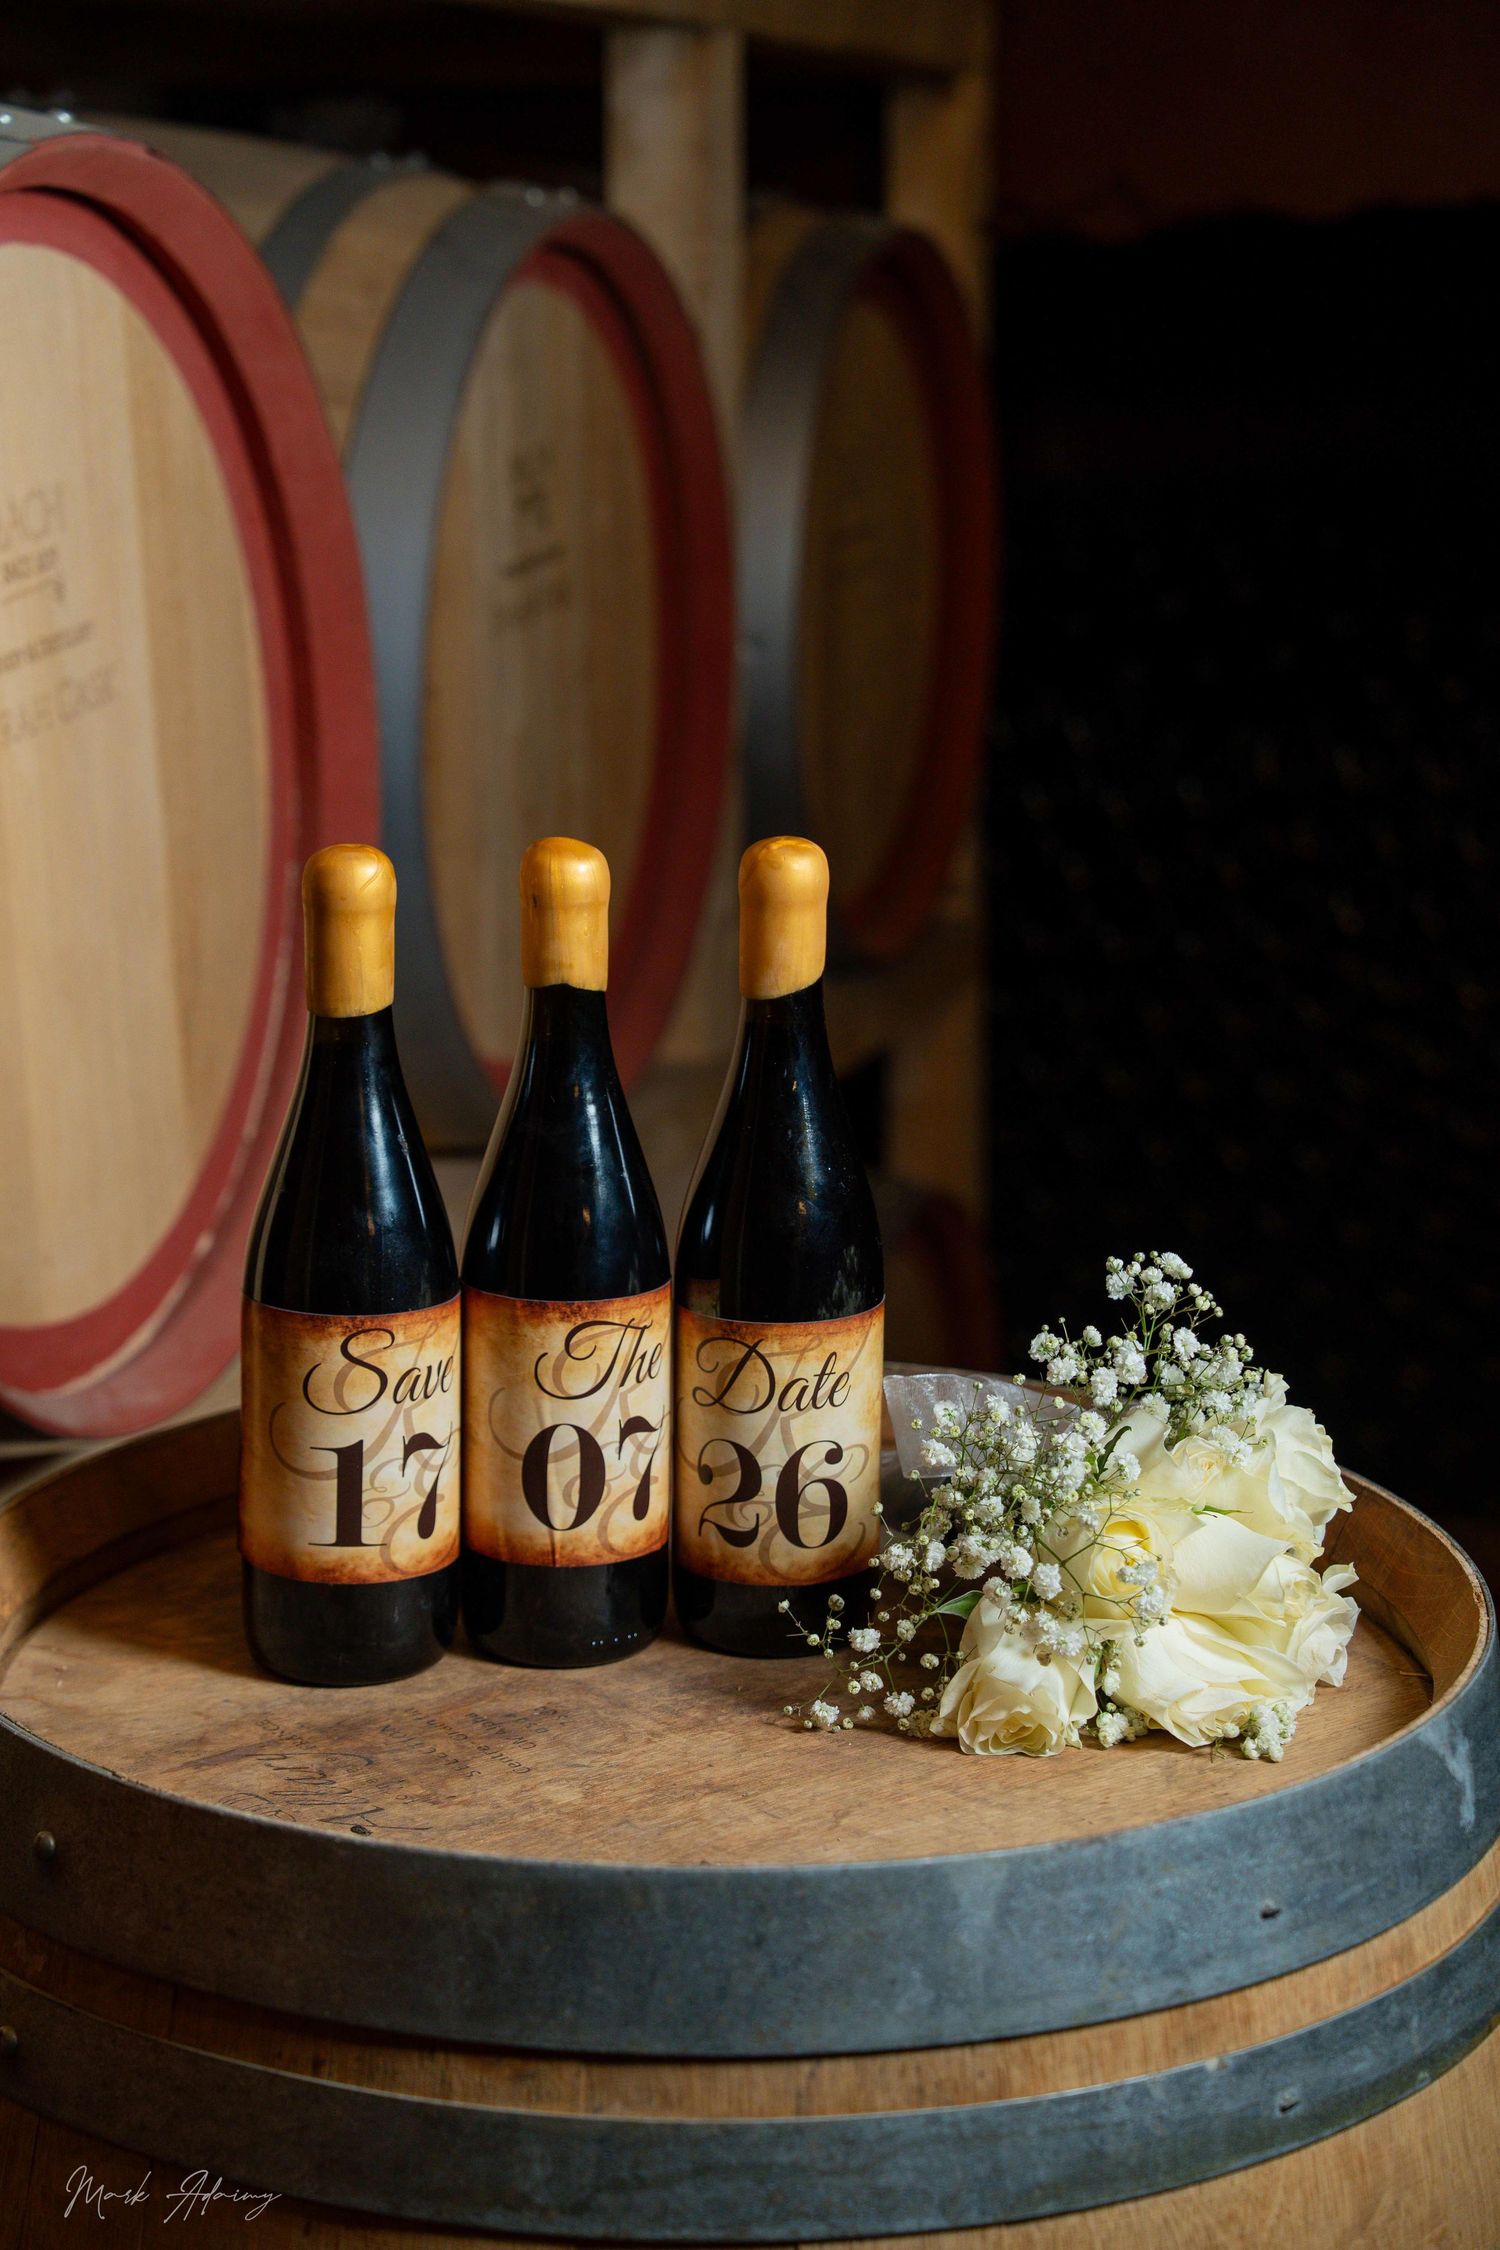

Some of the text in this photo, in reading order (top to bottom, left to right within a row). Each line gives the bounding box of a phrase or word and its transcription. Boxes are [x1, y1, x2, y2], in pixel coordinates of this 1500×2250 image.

[302, 1327, 454, 1416] Save
[534, 1317, 664, 1400] The
[692, 1335, 852, 1415] Date
[308, 1423, 453, 1547] 17
[521, 1405, 665, 1532] 07
[698, 1438, 849, 1550] 26
[378, 1724, 482, 1777] SELECTION
